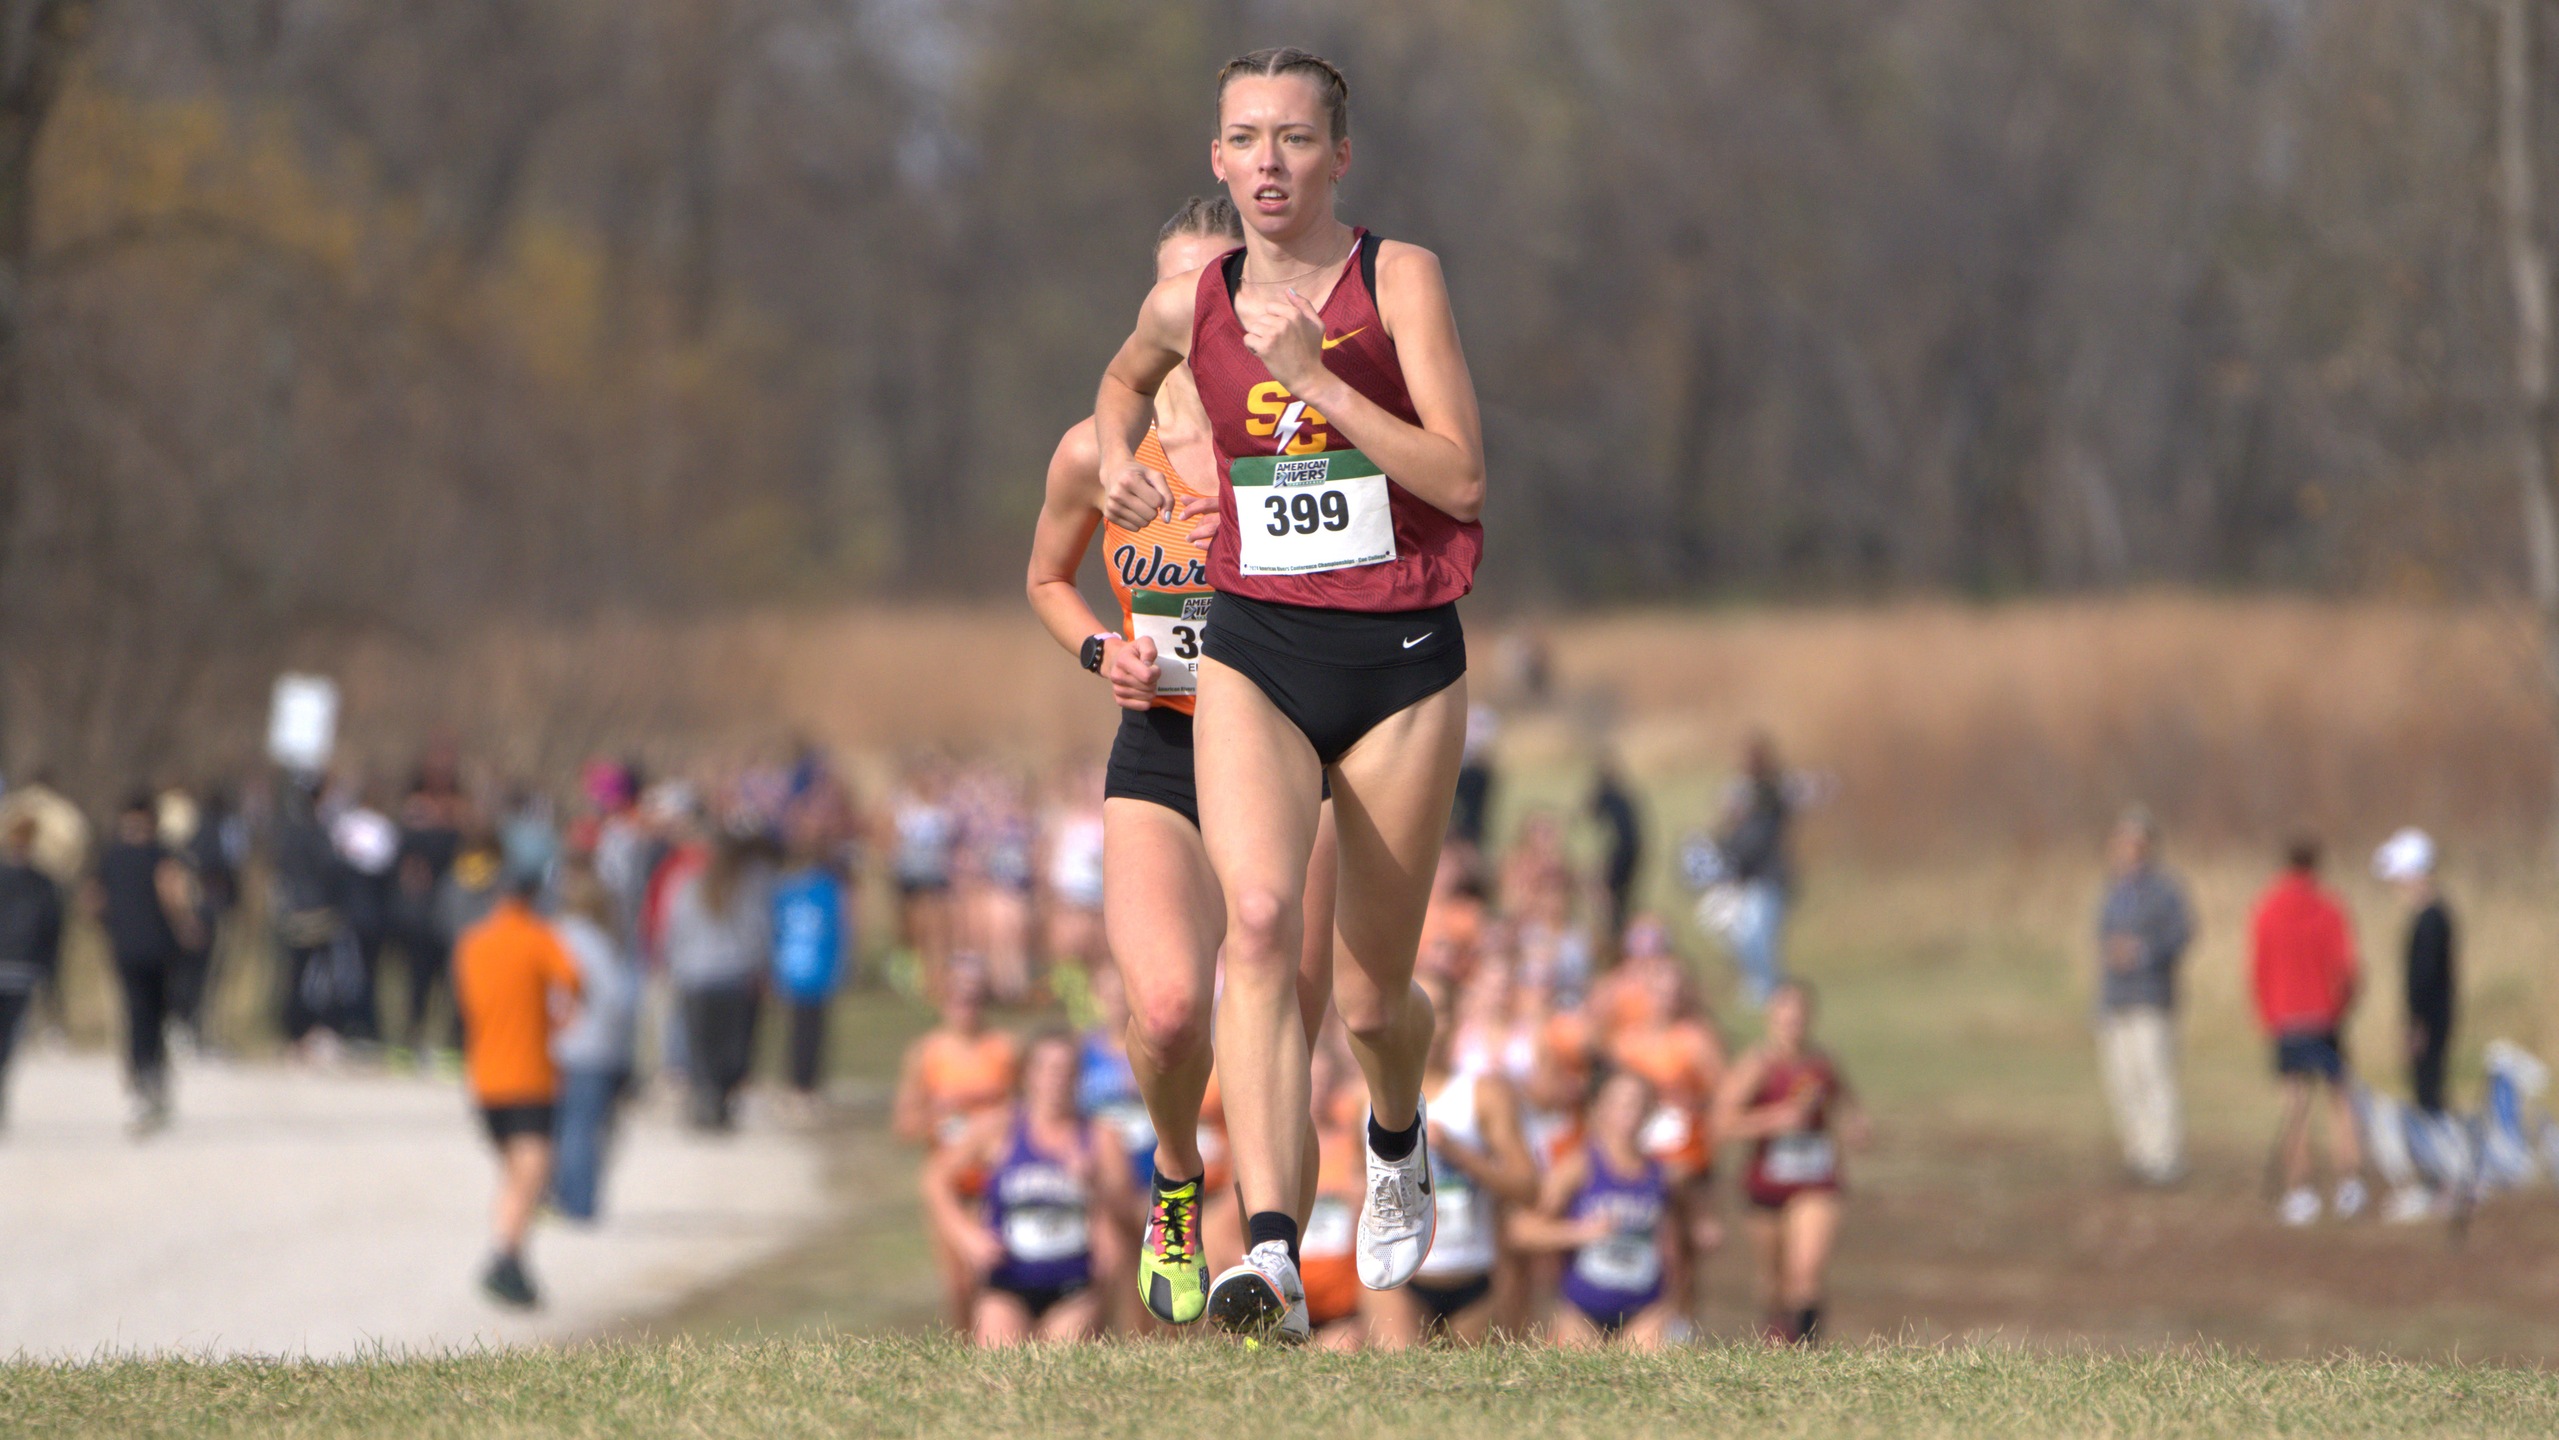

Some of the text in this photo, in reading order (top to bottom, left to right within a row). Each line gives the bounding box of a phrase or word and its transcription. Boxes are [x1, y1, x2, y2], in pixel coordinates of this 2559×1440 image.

[1277, 460, 1327, 471] AMERICAN
[1275, 469, 1326, 486] RIVERS
[1264, 490, 1349, 537] 399
[1290, 563, 1317, 572] Conference
[1318, 558, 1355, 568] Championships
[1172, 626, 1205, 659] 3
